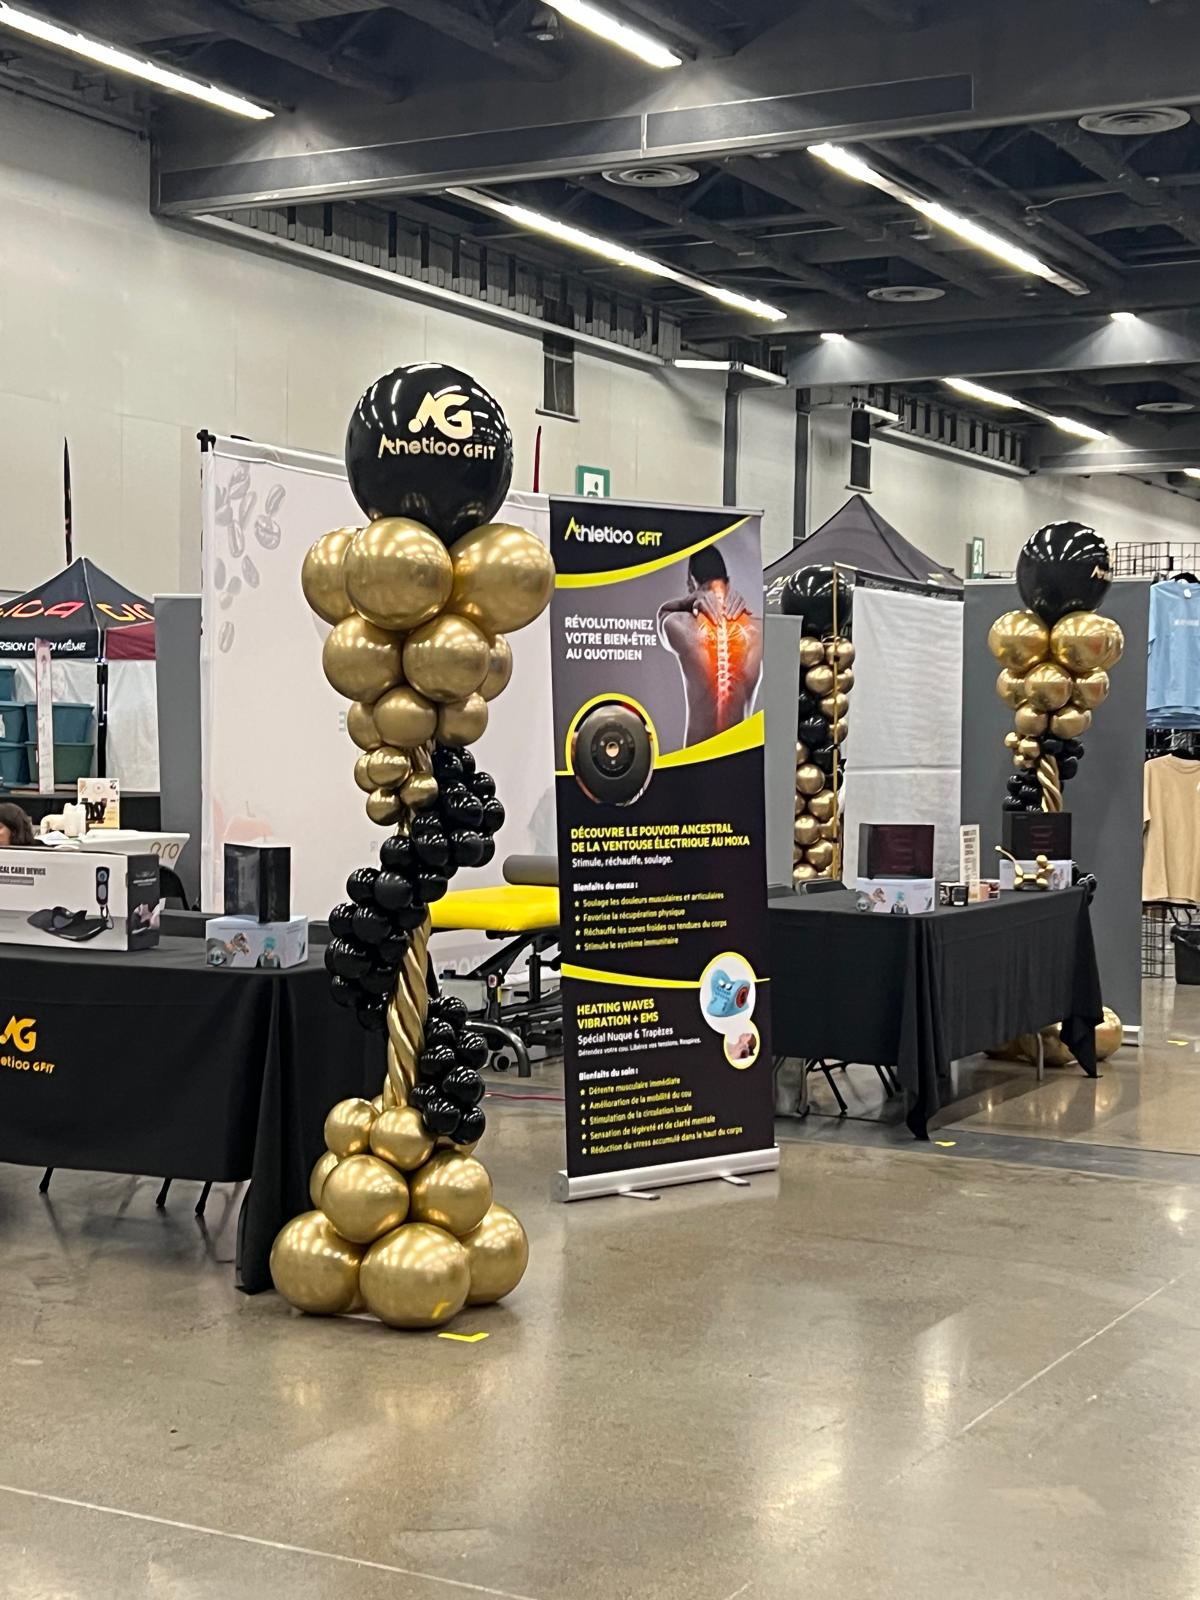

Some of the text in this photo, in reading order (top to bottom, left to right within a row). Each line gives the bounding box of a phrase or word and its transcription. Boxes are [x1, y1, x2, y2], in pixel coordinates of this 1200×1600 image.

[463, 444, 496, 460] GFIT
[564, 516, 662, 546] Athletioo GFIT
[0, 600, 85, 618] IDA
[565, 615, 654, 630] RÉVOLUTIONNEZ
[58, 638, 86, 651] MÊME
[566, 632, 656, 646] VOTRE BIEN-ÊTRE
[566, 648, 642, 660] AU QUOTIDIEN
[571, 824, 733, 838] DÉCOUVRE LE POUVOIR ANCESTRAL
[572, 836, 750, 852] DE LA VENTOUSE ÉLECTRIQUE AU MOXA
[572, 856, 604, 868] Stimule,
[644, 854, 674, 866] soulage.
[11, 866, 25, 874] CARE
[26, 867, 46, 876] DEVICE
[573, 882, 604, 892] Bienfaits
[605, 882, 614, 890] du
[583, 898, 608, 908] Soulage
[610, 898, 620, 906] les
[620, 896, 647, 905] douleurs
[648, 894, 682, 903] musculaires
[692, 892, 724, 900] articulaires
[584, 908, 686, 922] Favorise la récupération physique
[584, 926, 616, 936] Réchauffe
[618, 926, 626, 934] les
[646, 923, 666, 932] froides
[676, 921, 701, 930] tendues
[702, 920, 710, 928] du
[712, 920, 727, 929] corps
[584, 937, 678, 950] Stimule le système immunitaire
[577, 998, 654, 1016] HEATING WAVES
[577, 1016, 630, 1030] VIBRATION
[640, 1012, 658, 1024] EMS
[578, 1027, 674, 1045] Spécial Nuque & Trapèzes
[32, 1062, 55, 1074] GFIT
[578, 1070, 610, 1080] Bienfaits
[610, 1068, 620, 1078] du
[621, 1066, 635, 1076] soin
[588, 1078, 680, 1096] Détente musculaire immédiate
[589, 1090, 692, 1110] Amélioration de la mobilité du cou
[590, 1104, 692, 1126] Stimulation de la circulation locale
[590, 1115, 716, 1140] Sensation de légèreté et de clarté mentale
[590, 1126, 743, 1154] Réduction du stress accumulé dans le haut du corps
